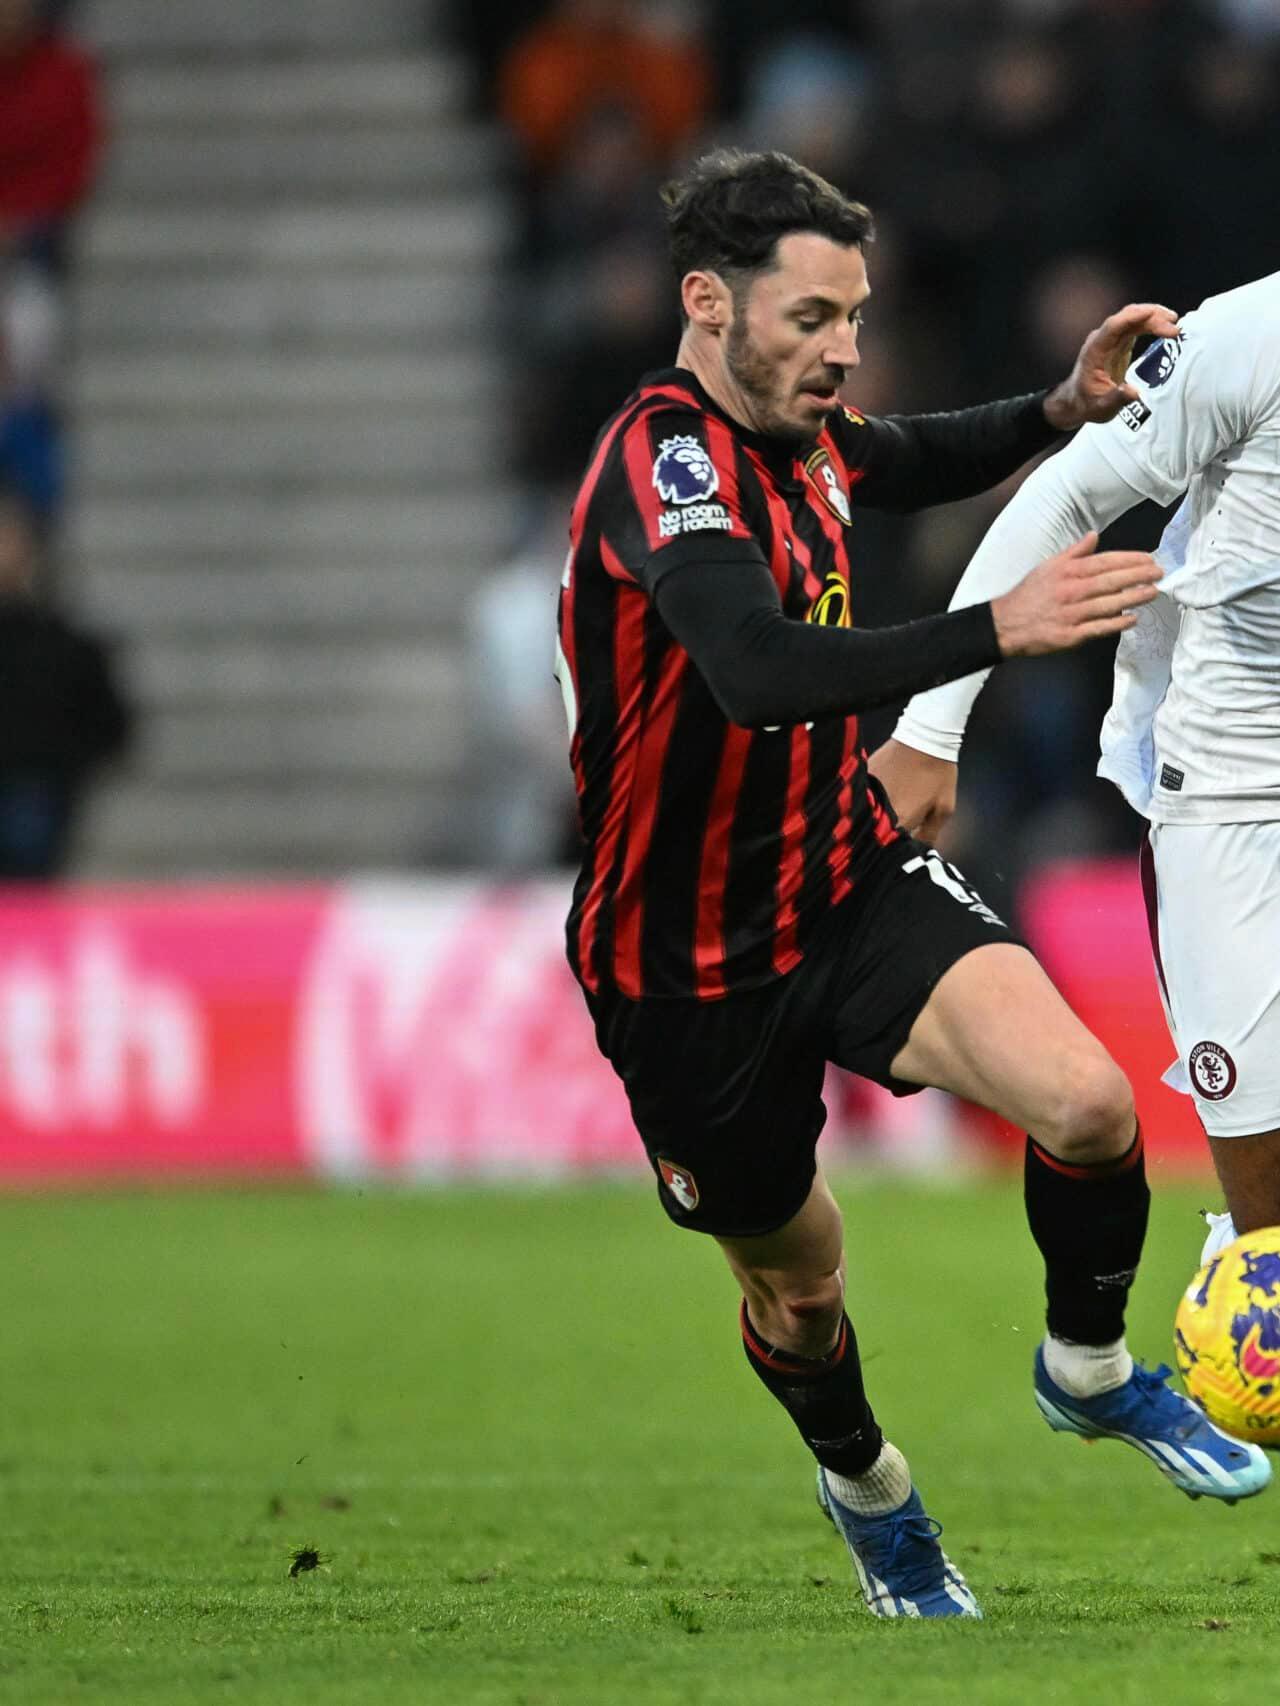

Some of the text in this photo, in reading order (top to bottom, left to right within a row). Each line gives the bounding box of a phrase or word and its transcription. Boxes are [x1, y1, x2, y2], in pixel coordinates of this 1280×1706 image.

[658, 504, 726, 527] No room
[1190, 1043, 1227, 1064] ASTON VILLA
